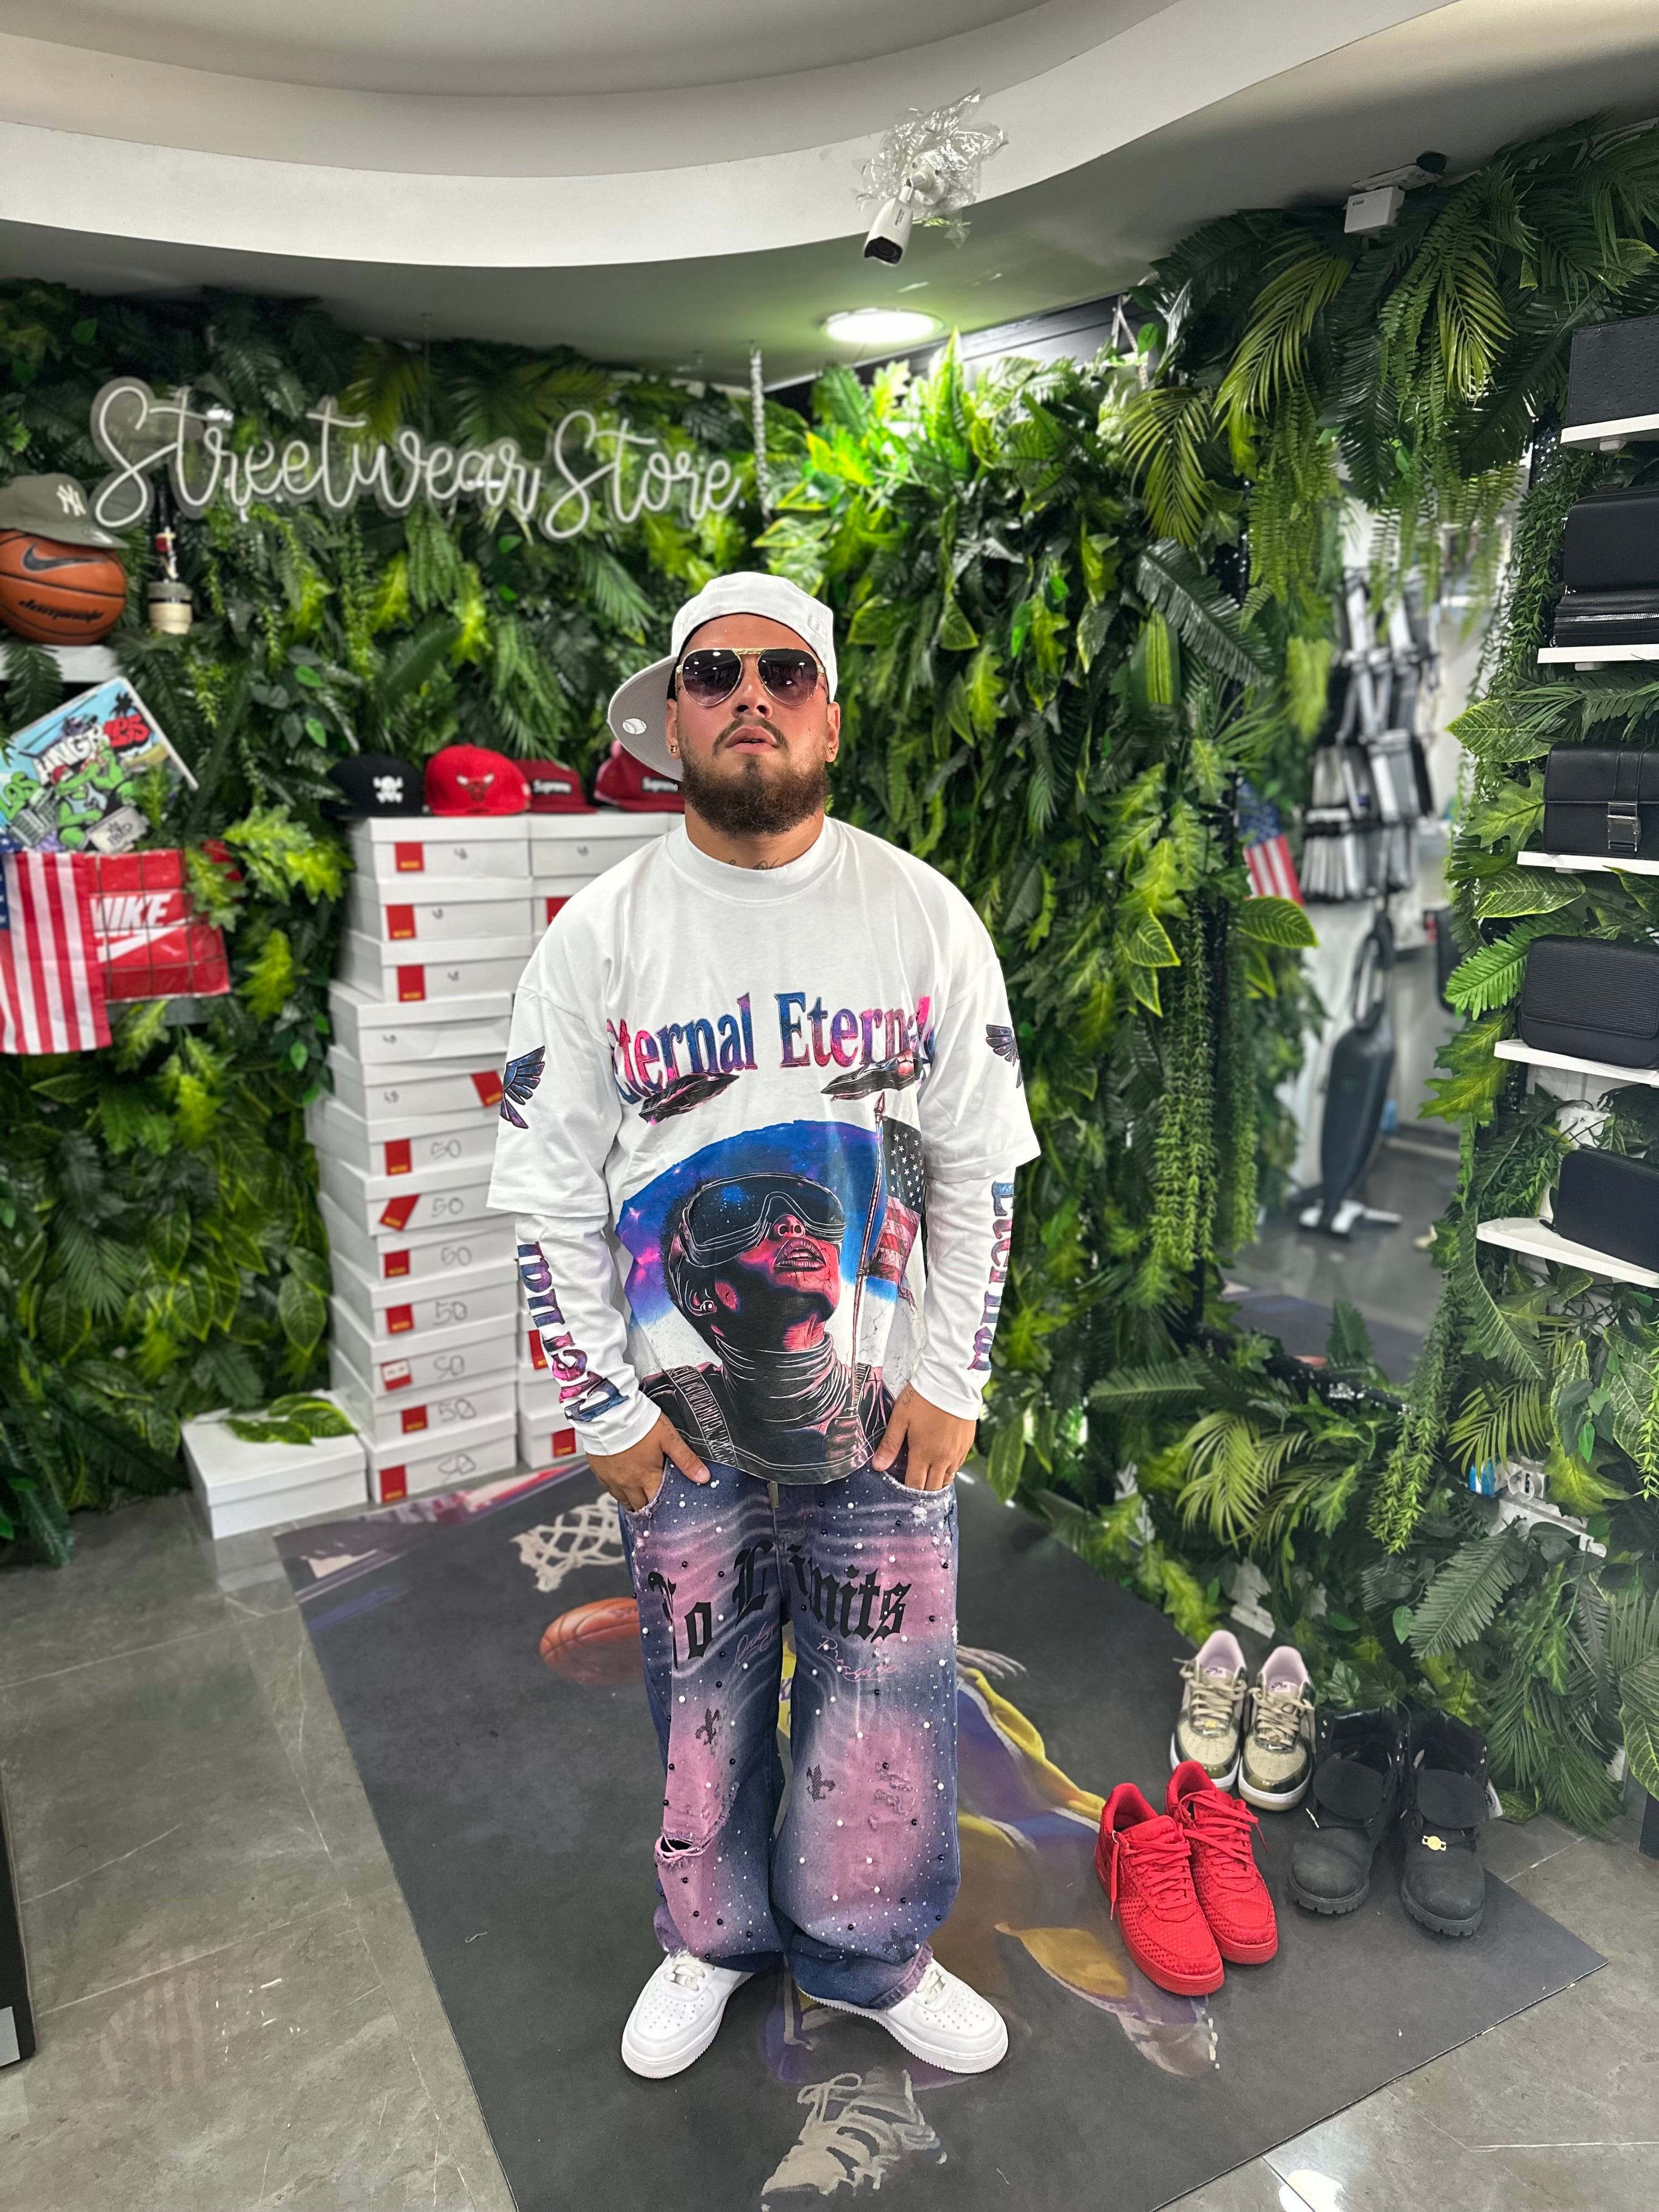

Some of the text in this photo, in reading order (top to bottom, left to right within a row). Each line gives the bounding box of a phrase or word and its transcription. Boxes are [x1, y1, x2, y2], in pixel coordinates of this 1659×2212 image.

[95, 386, 742, 538] Streetwear Store
[90, 893, 172, 939] NIKE
[606, 991, 932, 1104] ternal Etern
[431, 1197, 464, 1218] 50
[441, 1246, 472, 1266] 50
